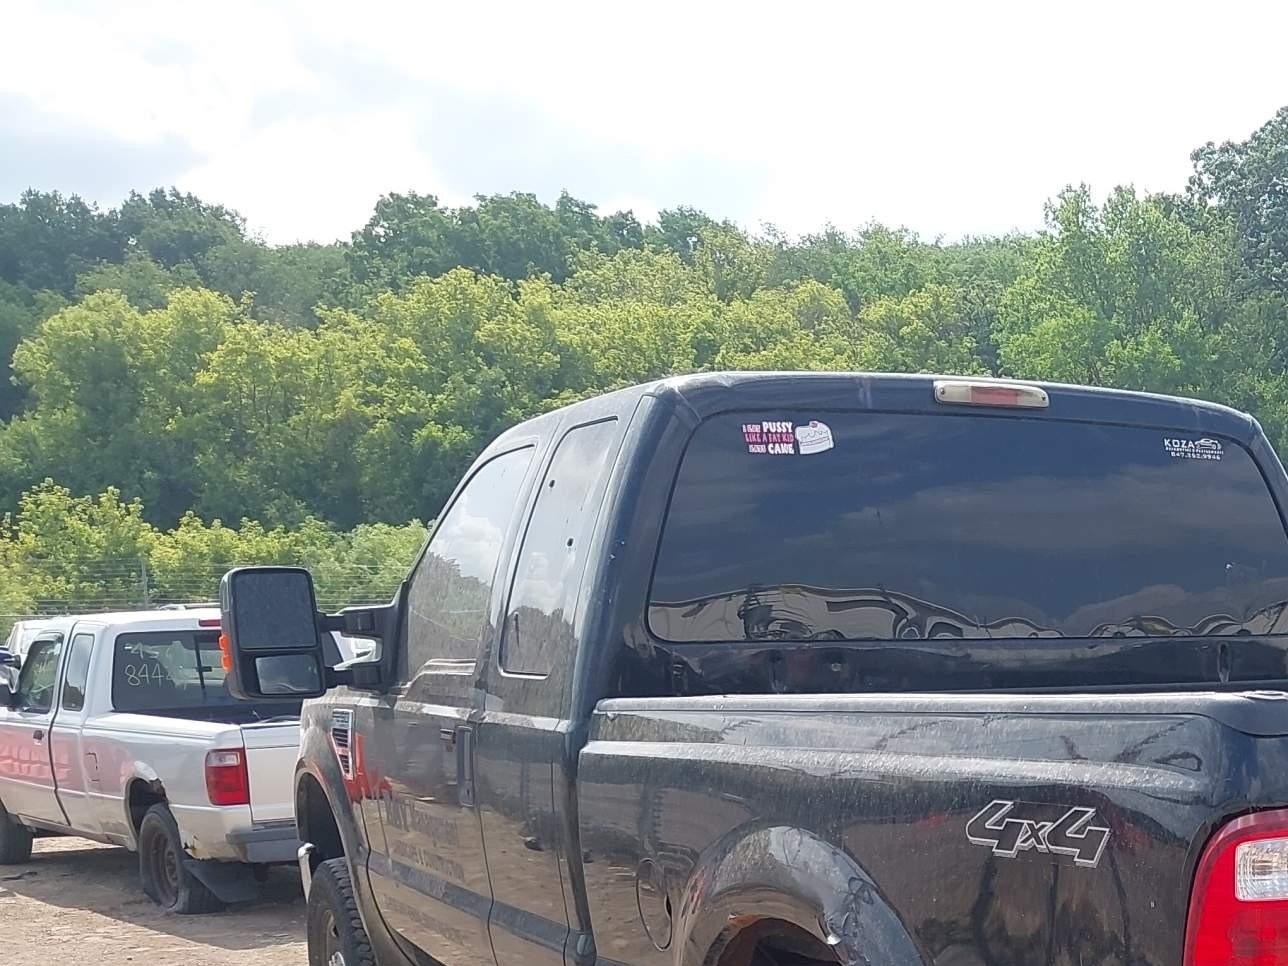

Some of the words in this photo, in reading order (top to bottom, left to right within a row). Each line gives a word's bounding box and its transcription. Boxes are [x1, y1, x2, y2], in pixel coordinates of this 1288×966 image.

[762, 421, 793, 433] PUSSY
[744, 433, 762, 443] LIKE
[762, 433, 768, 443] A
[768, 433, 781, 443] FAT
[781, 433, 795, 443] KID
[1164, 438, 1195, 449] KOZA
[767, 443, 795, 455] CAKE
[966, 800, 1112, 868] 4x4
